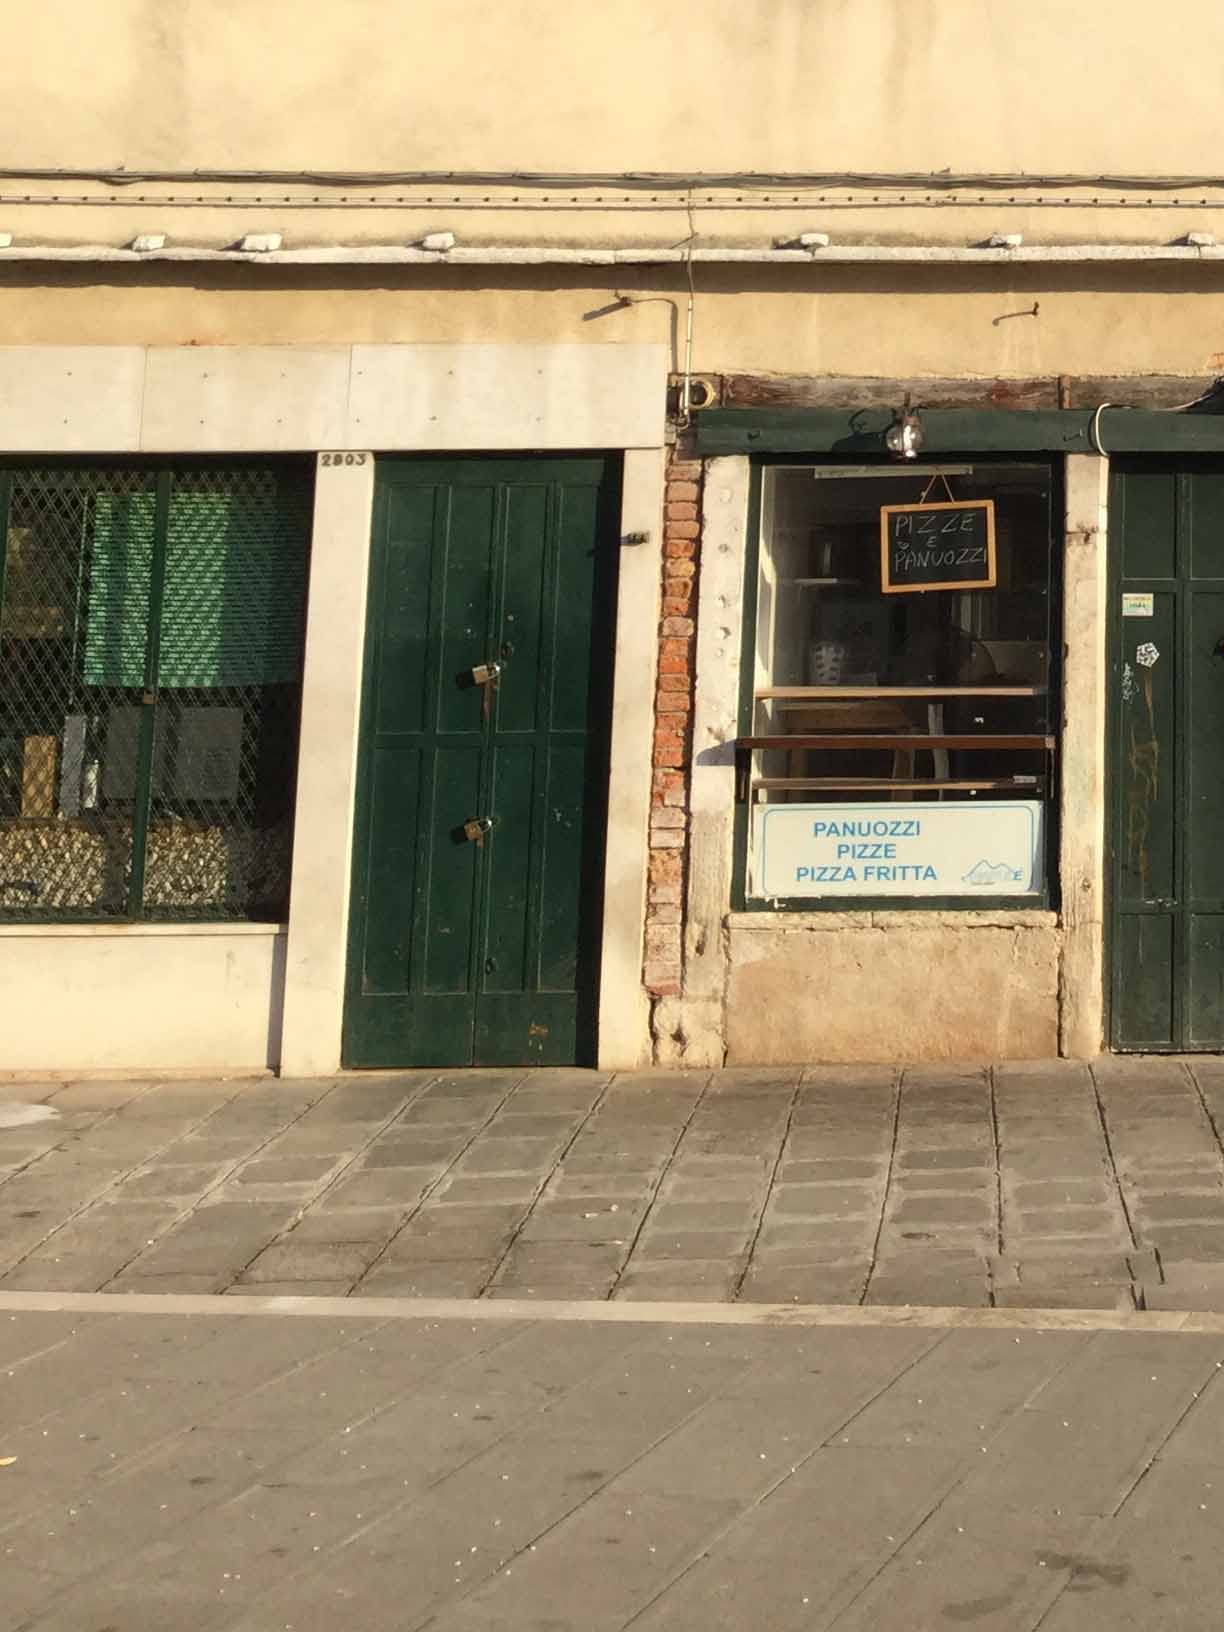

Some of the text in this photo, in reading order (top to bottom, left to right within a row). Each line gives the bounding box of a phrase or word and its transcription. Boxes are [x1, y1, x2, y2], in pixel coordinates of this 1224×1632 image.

[895, 512, 976, 537] PIZZE
[895, 546, 987, 573] PANUOZZI
[813, 820, 921, 837] PANUOZZI
[837, 843, 897, 859] PIZZE
[796, 865, 938, 882] PIZZA FRITTA
